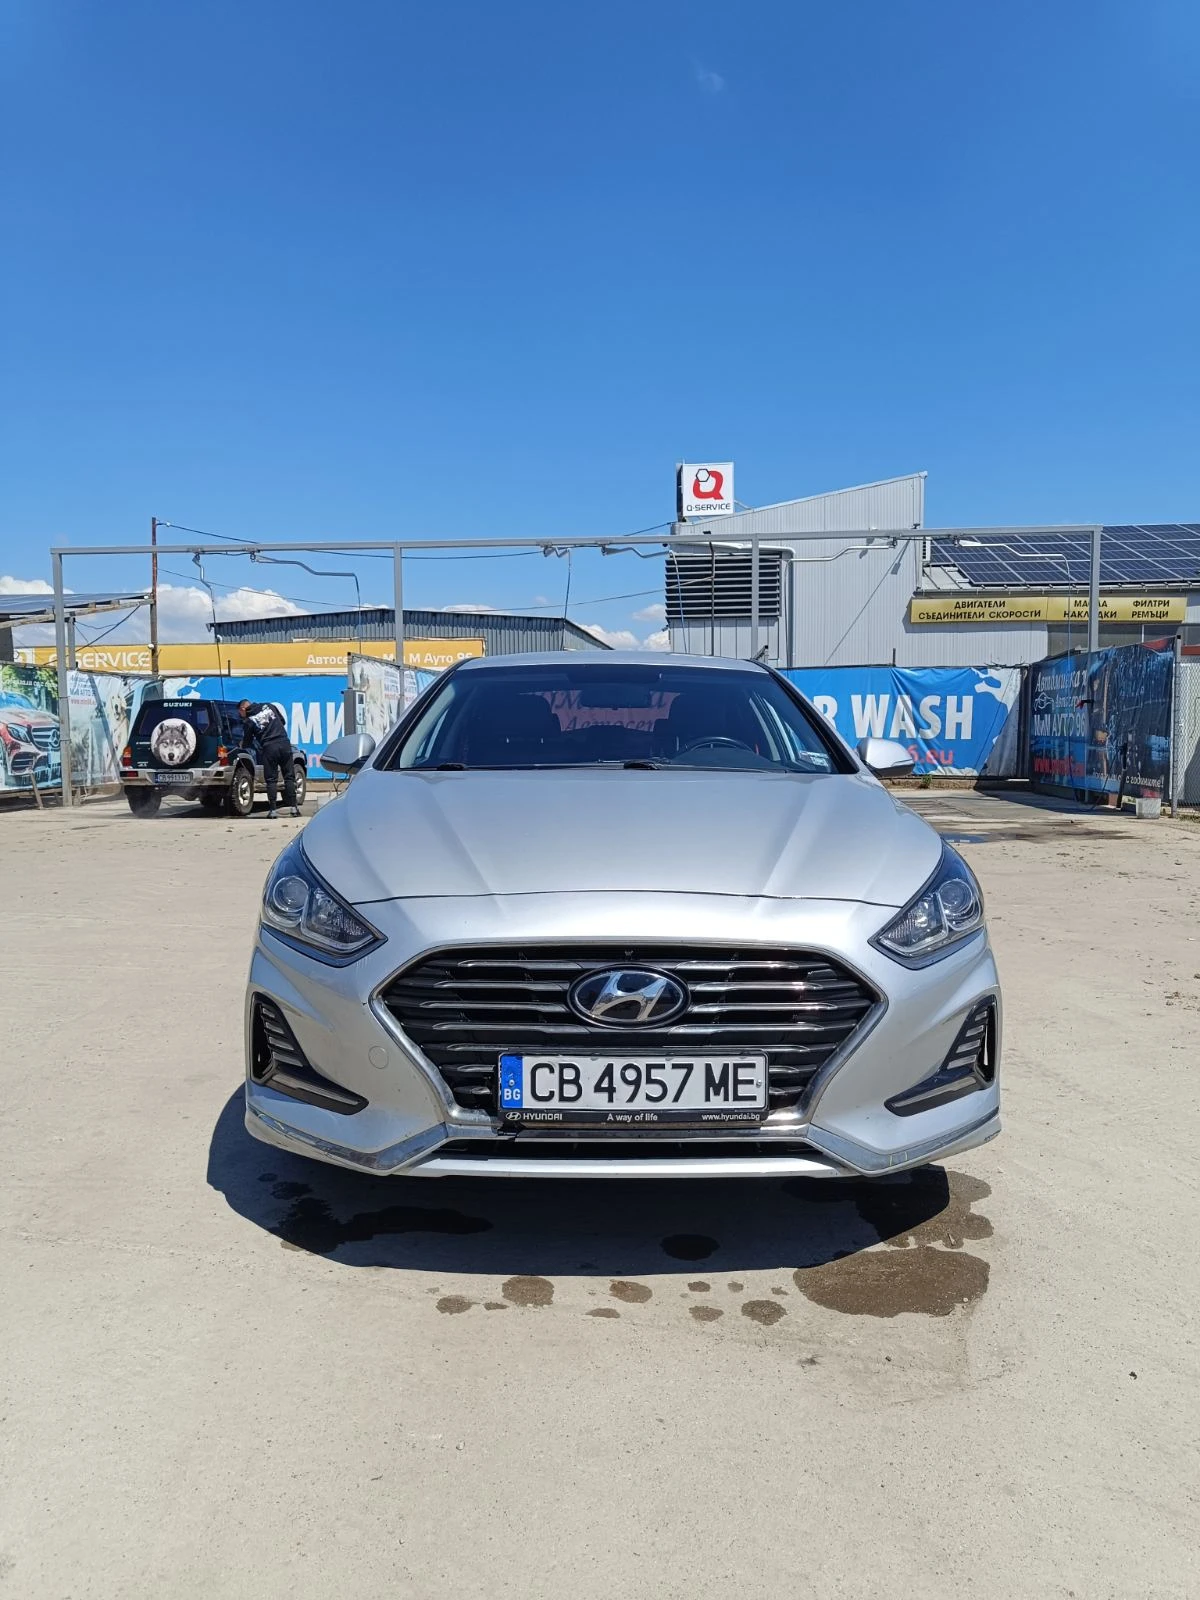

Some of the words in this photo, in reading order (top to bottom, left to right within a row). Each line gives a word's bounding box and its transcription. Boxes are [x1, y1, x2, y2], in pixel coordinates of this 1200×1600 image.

[954, 600, 1006, 609] ДВИГАТЕЛИ
[1133, 599, 1170, 608] ФИЛТРИ
[918, 611, 985, 621] СЪЕДИНИТЕЛИ
[988, 610, 1041, 619] СКОРОСТИ
[1131, 610, 1169, 619] РЕМЪЦИ
[424, 653, 453, 665] Ауто
[850, 694, 974, 740] WASH
[529, 1062, 583, 1103] CB
[593, 1062, 694, 1104] 4957
[704, 1062, 758, 1103] ME
[503, 1089, 521, 1101] BG
[523, 1112, 563, 1121] HYUNDAI
[607, 1112, 614, 1121] A
[615, 1114, 633, 1123] way
[634, 1112, 644, 1121] of
[645, 1112, 658, 1121] life
[702, 1112, 760, 1122] www.hyundai.bg
